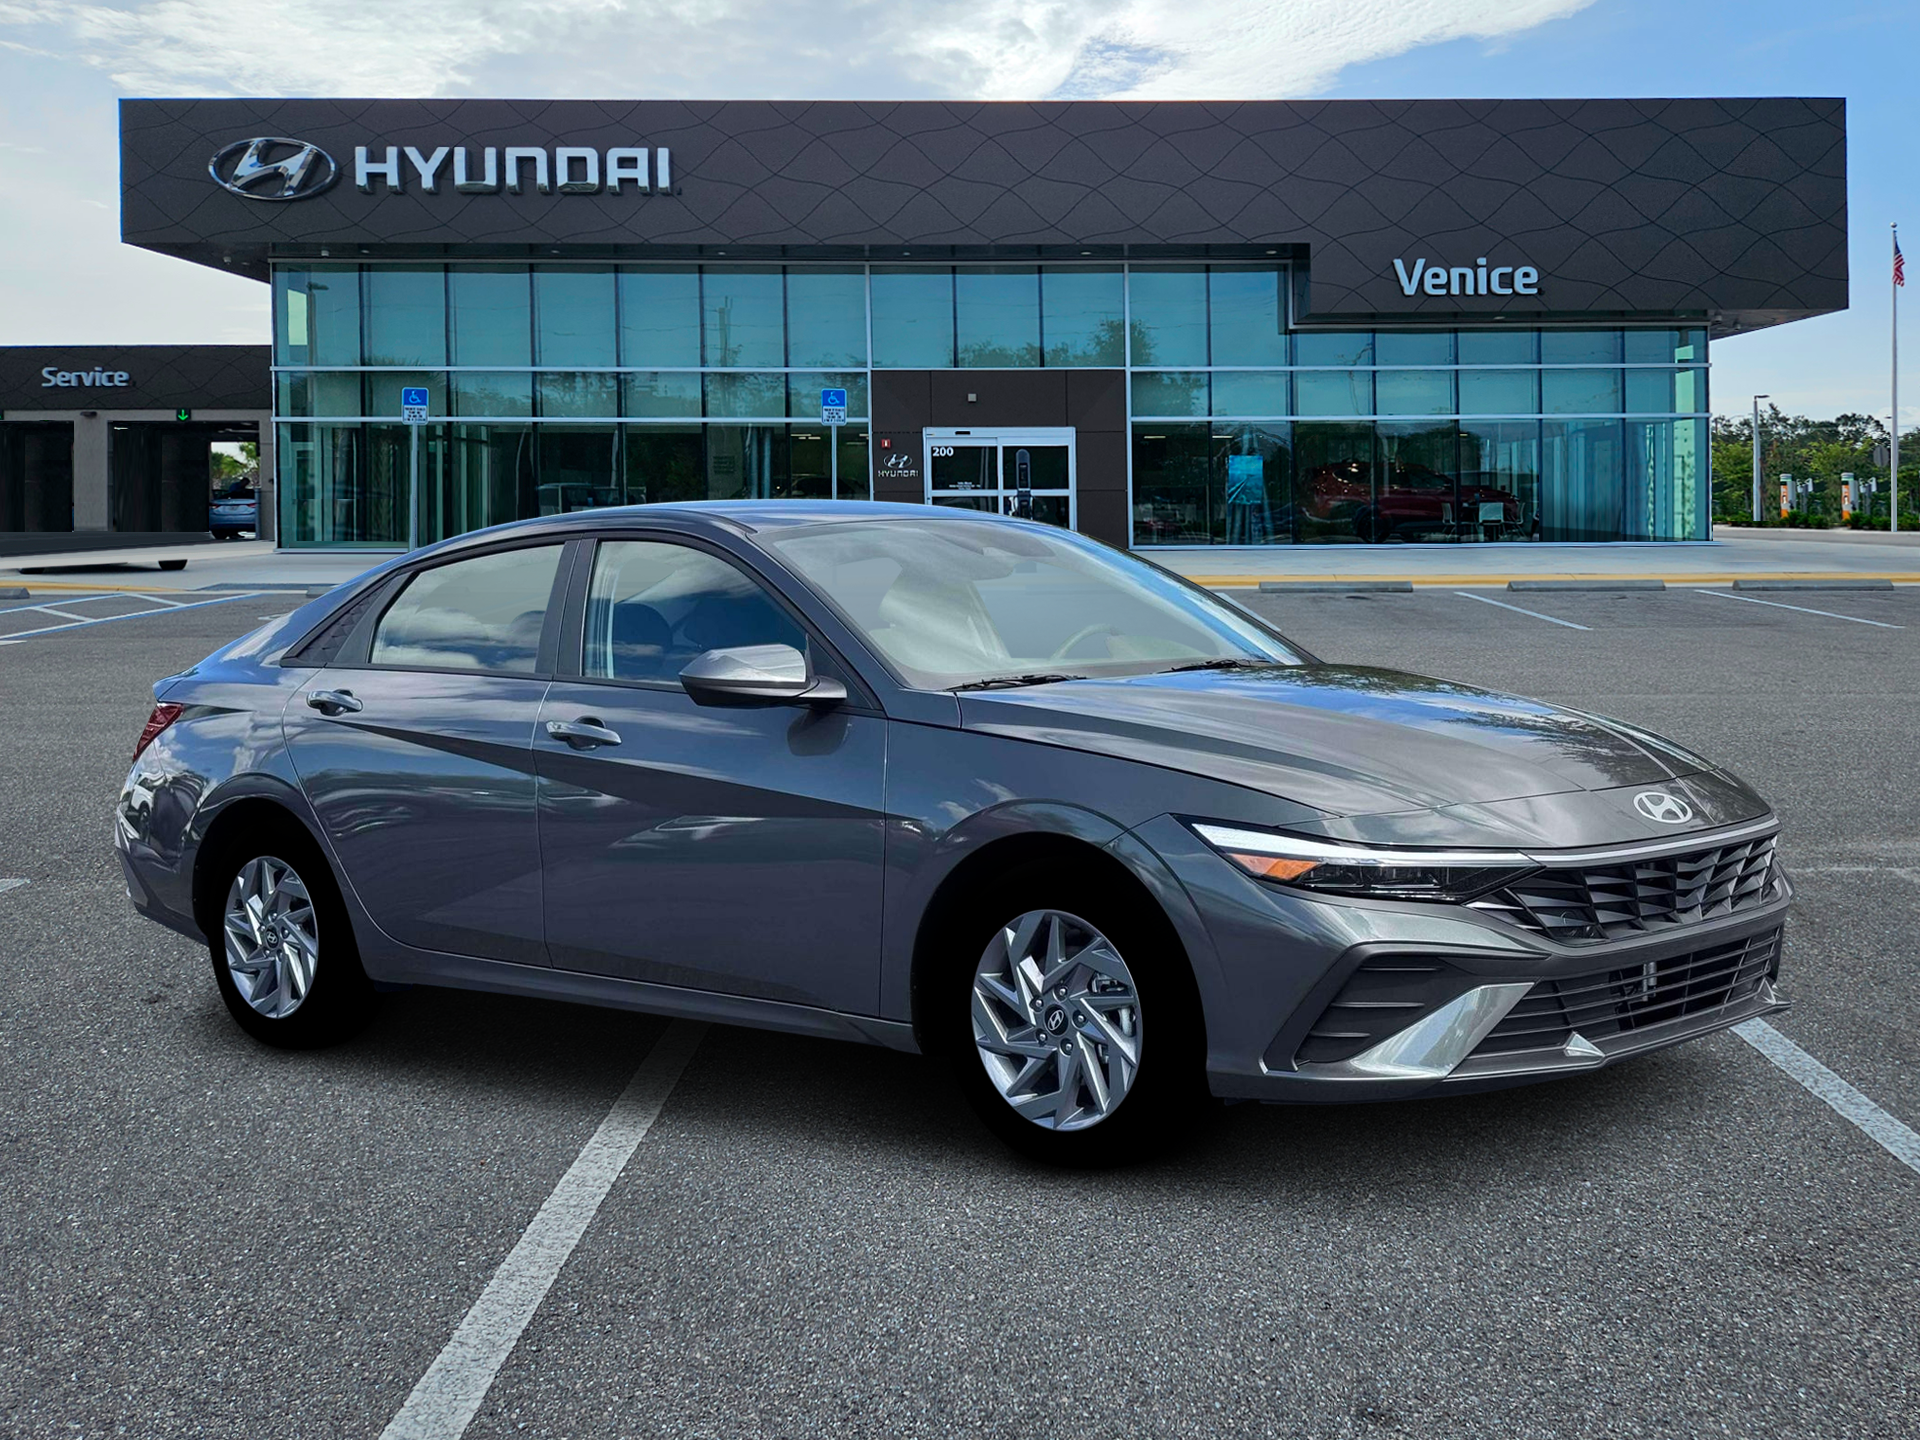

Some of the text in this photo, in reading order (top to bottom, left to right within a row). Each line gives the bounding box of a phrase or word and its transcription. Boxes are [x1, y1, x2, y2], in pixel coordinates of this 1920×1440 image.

[354, 146, 671, 193] HYUNDAI
[1392, 257, 1539, 296] Venice
[41, 366, 130, 387] Service
[932, 446, 954, 457] 200
[877, 470, 919, 478] HYUNDAI
